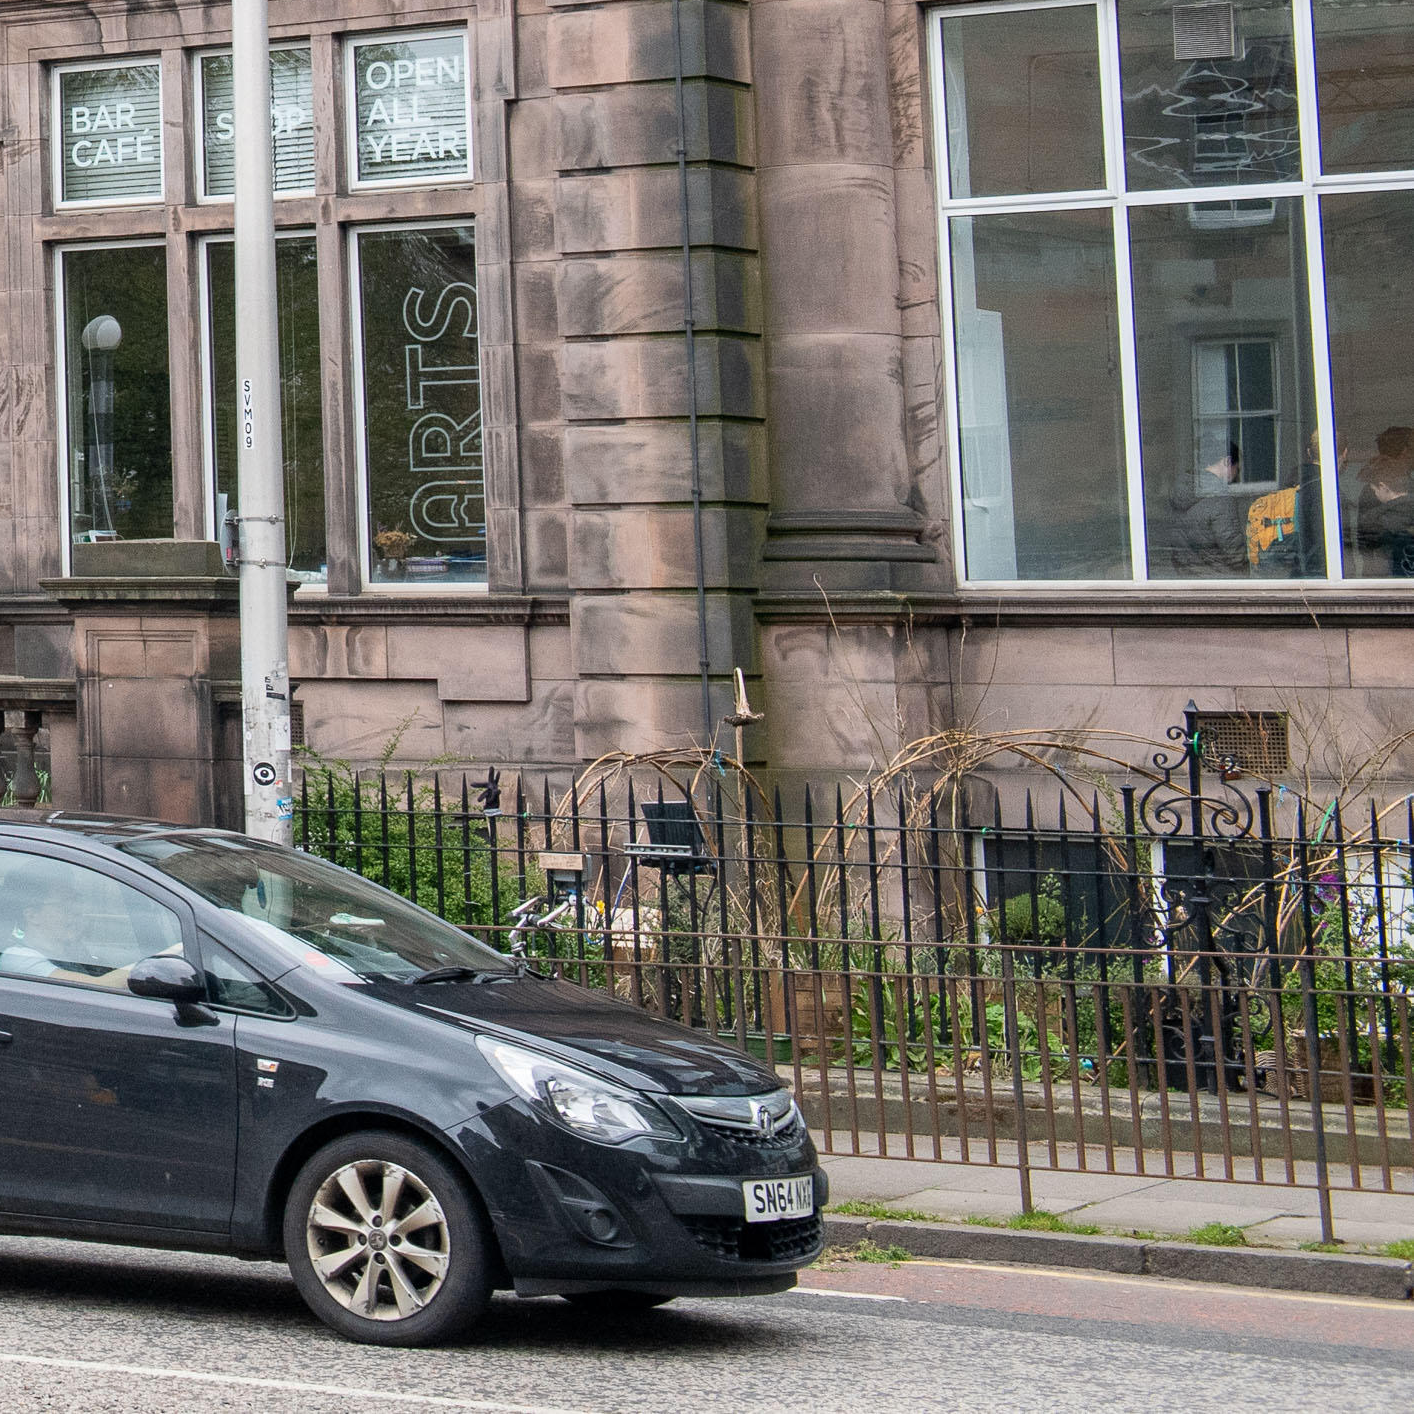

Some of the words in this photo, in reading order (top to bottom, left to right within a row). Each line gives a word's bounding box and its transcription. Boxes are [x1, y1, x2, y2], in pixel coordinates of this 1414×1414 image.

[366, 55, 460, 90] OPEN
[71, 103, 135, 134] BAR
[217, 105, 306, 141] SOP
[367, 94, 431, 127] ALL
[71, 130, 155, 168] CAFÉ
[367, 129, 460, 163] YEAR
[403, 282, 487, 542] ARTS
[753, 1181, 794, 1214] SN64
